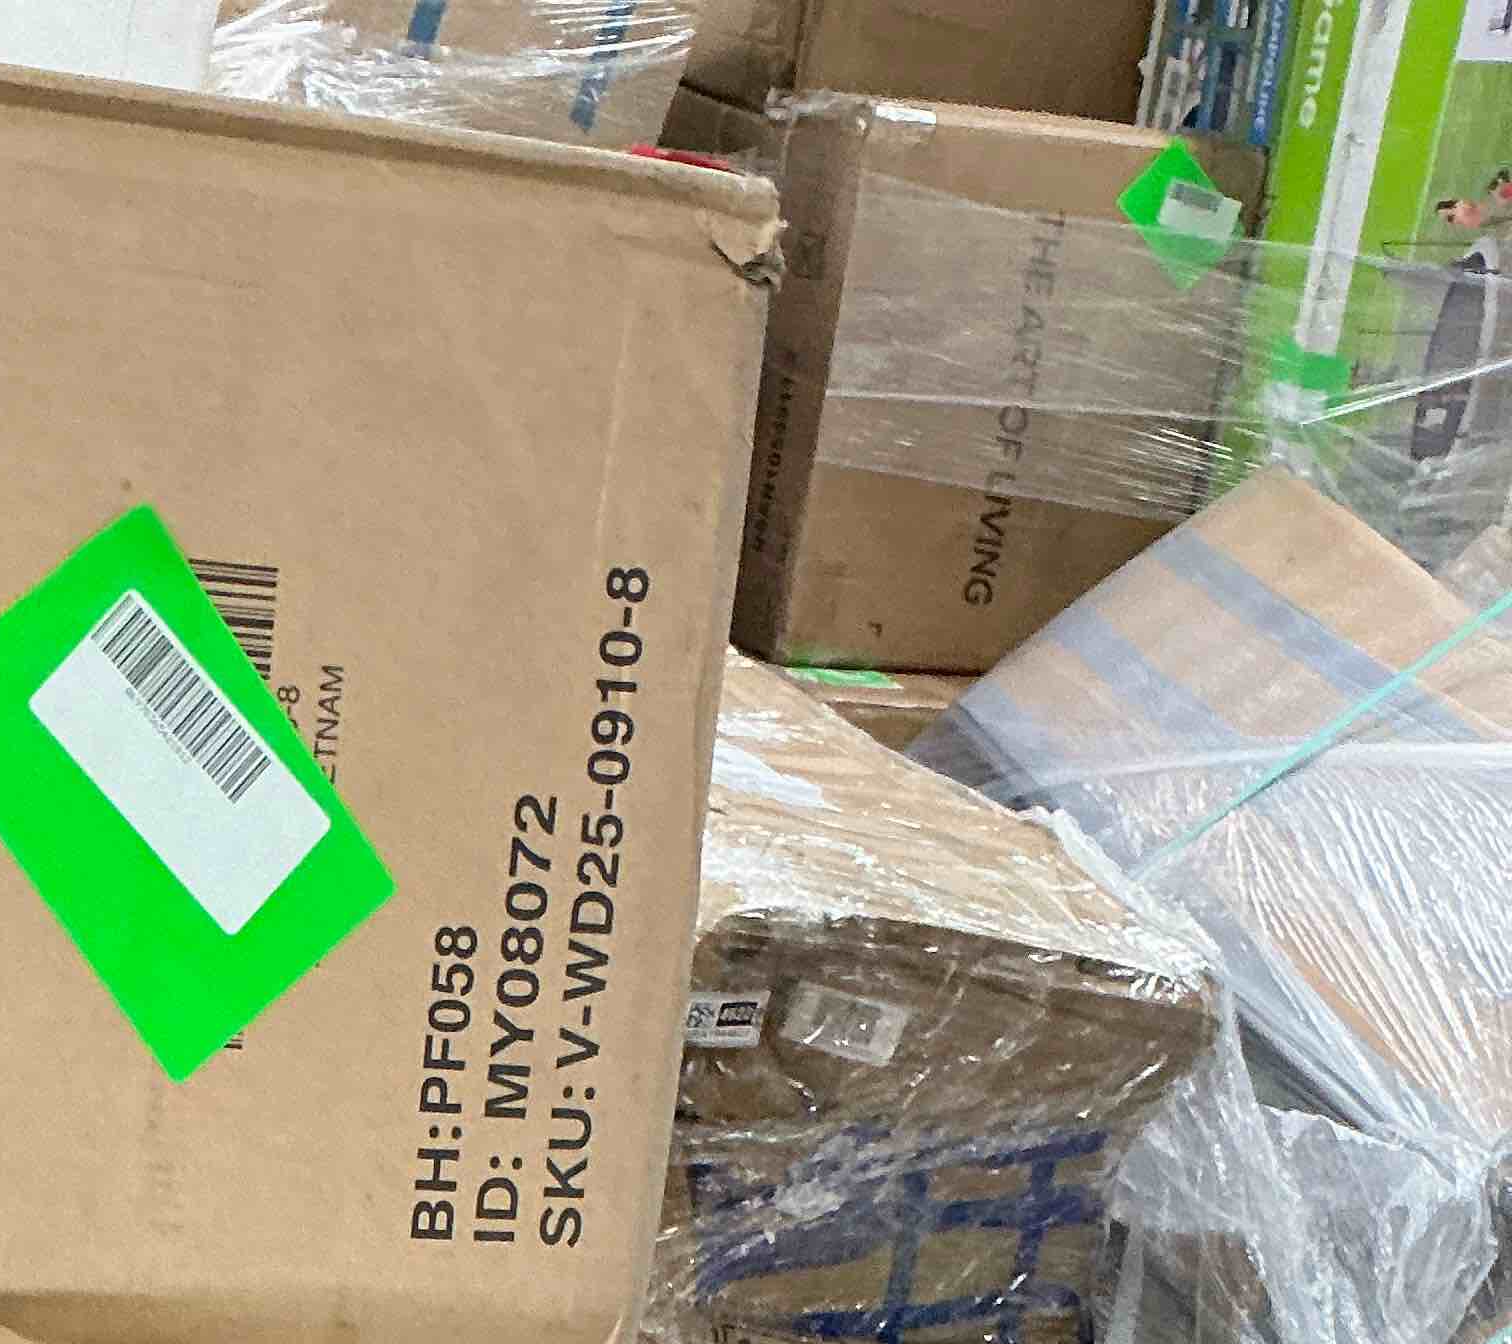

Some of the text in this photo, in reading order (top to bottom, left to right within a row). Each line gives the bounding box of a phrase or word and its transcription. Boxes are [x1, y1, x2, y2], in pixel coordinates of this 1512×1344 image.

[963, 470, 1017, 608] LIVING
[992, 405, 1030, 461] OF
[471, 793, 560, 1240] ID: MY08072
[537, 565, 652, 1247] SKU: V-WD25-0910-8
[406, 925, 483, 1239] BH:PF058
